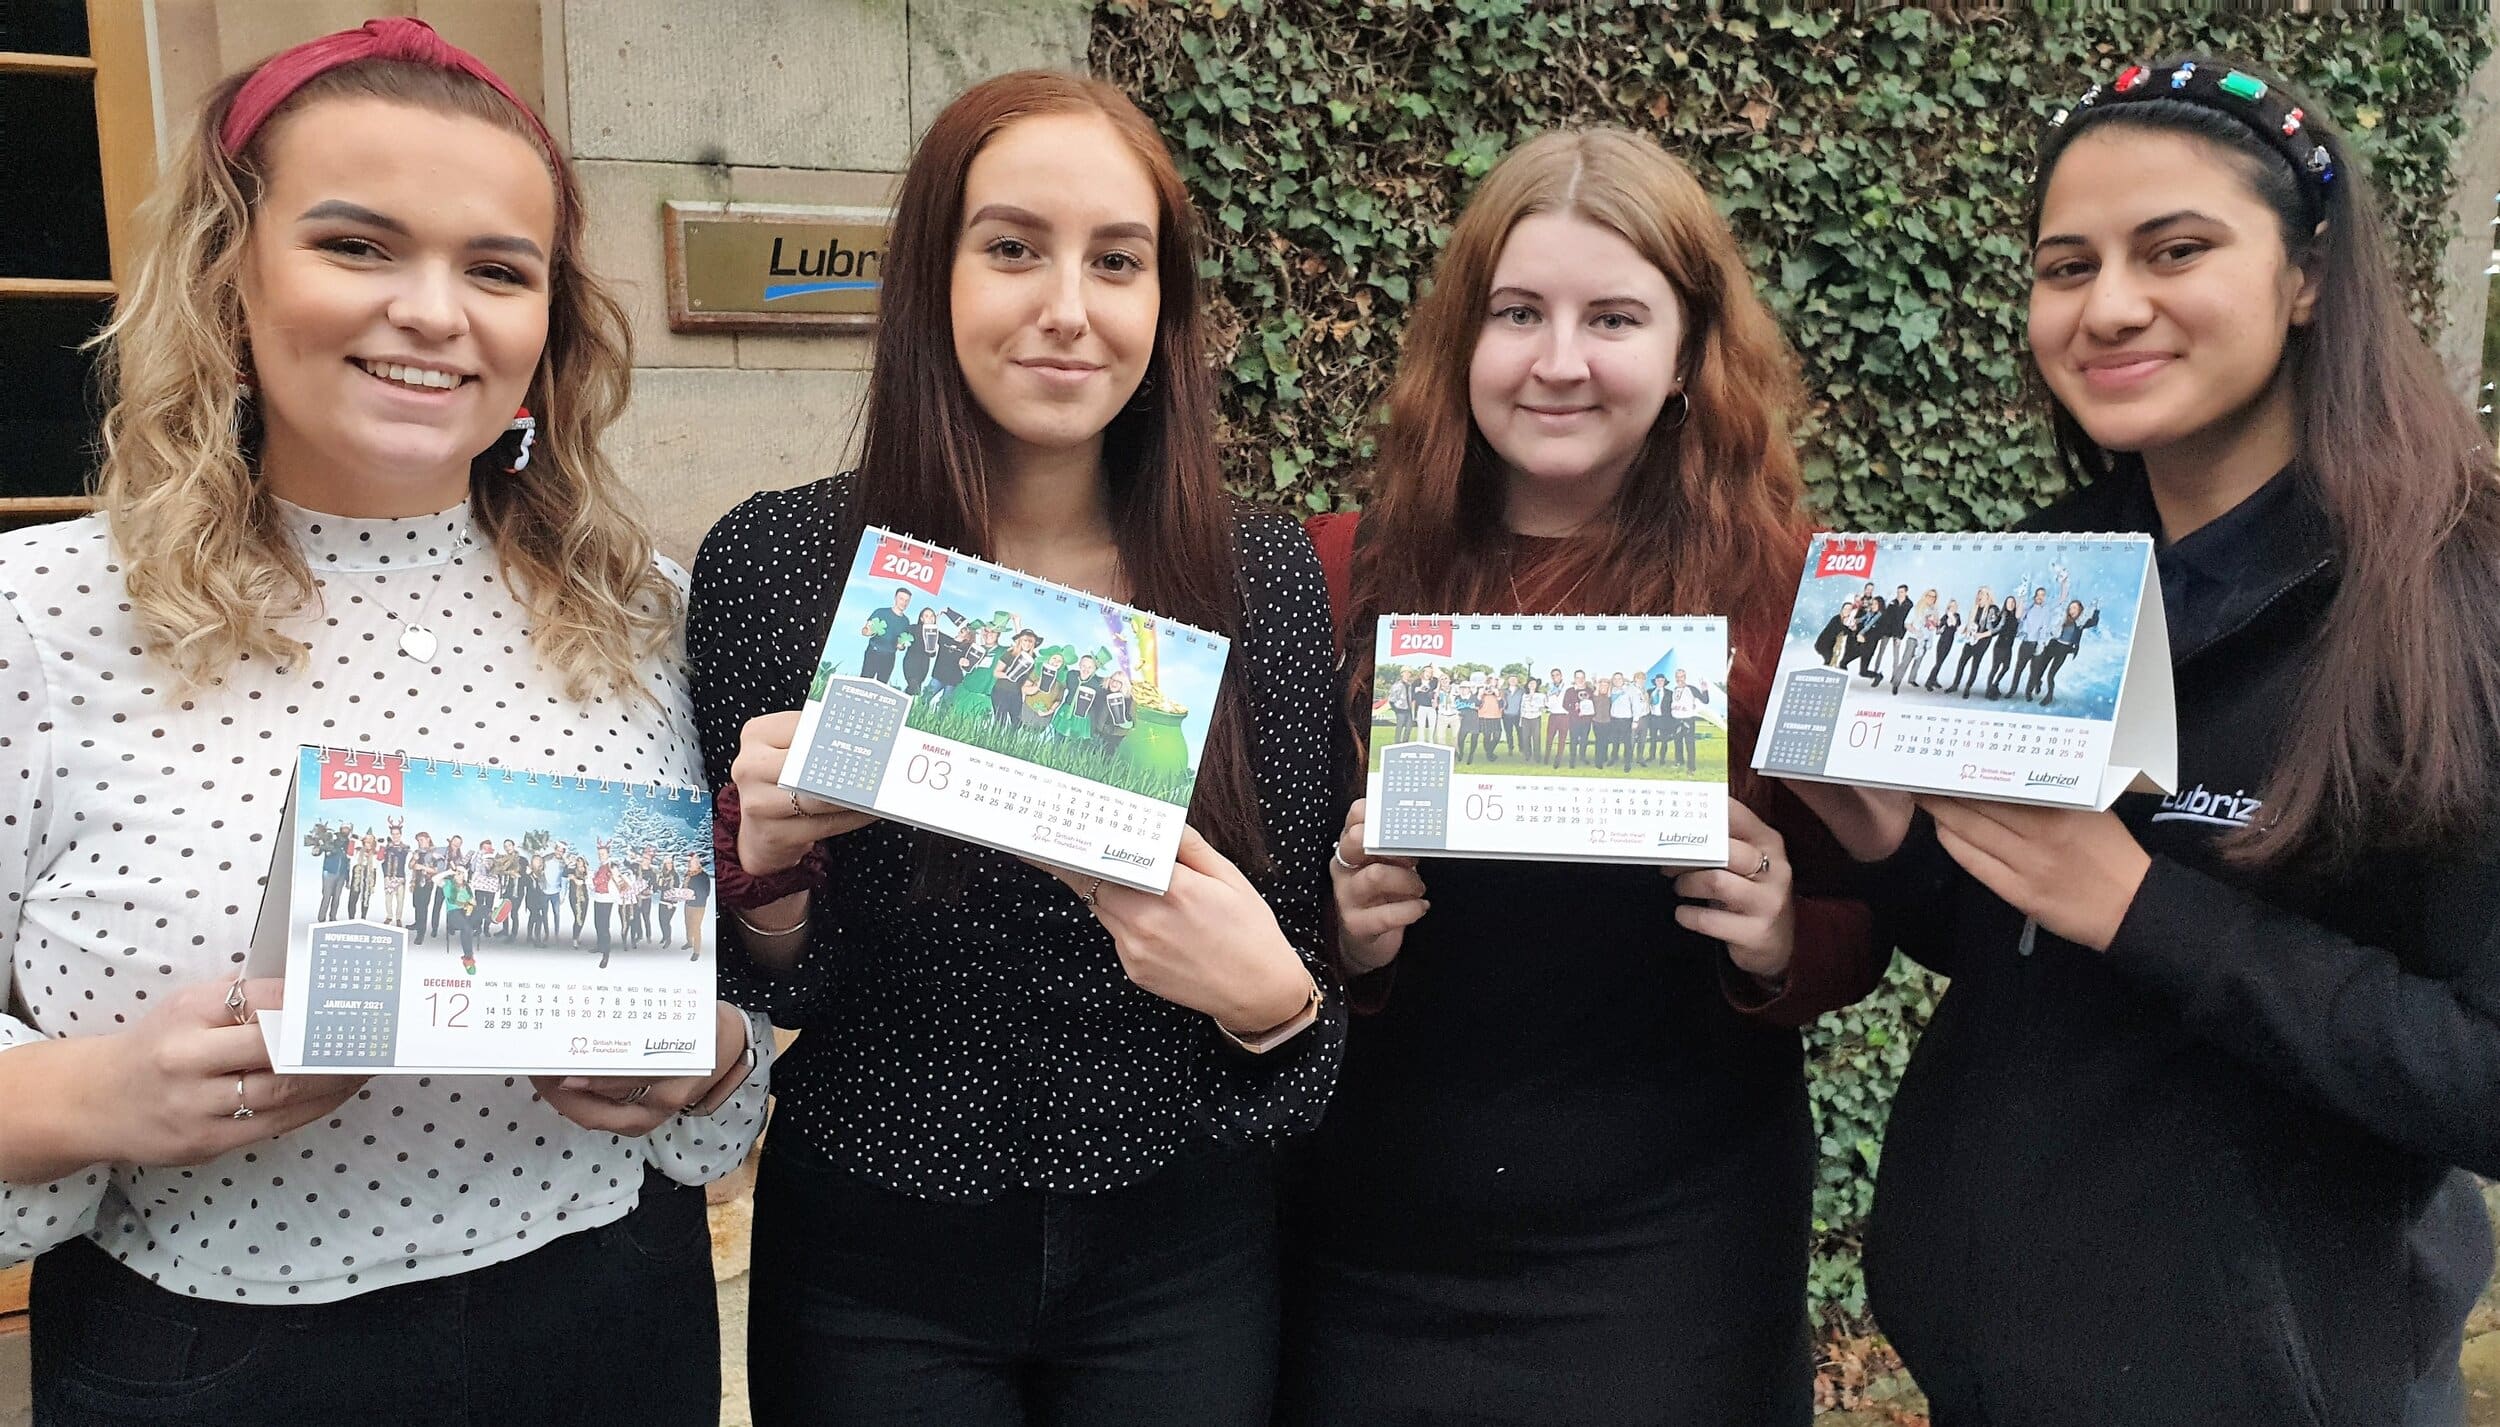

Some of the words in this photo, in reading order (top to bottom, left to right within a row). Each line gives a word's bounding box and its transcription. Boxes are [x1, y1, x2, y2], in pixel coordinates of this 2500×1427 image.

[883, 554, 934, 583] 2020
[1825, 555, 1867, 572] 2020
[1400, 634, 1444, 650] 2020
[1855, 710, 1885, 718] JANUARY
[1849, 721, 1882, 750] 01
[922, 744, 951, 757] MARCH
[907, 755, 951, 790] 03
[2028, 770, 2079, 786] Lubrizol
[333, 771, 391, 795] 2020
[959, 789, 970, 799] 23
[974, 794, 984, 802] 24
[989, 798, 999, 806] 25
[1004, 802, 1013, 811] 26
[1018, 806, 1029, 814] 27
[1062, 818, 1072, 827] 30
[1076, 822, 1086, 831] 31
[965, 779, 971, 787] 9
[979, 783, 988, 791] 10
[994, 787, 1002, 795] 11
[1008, 791, 1017, 800] 12
[1023, 795, 1032, 804] 13
[1066, 807, 1075, 816] 16
[1109, 820, 1118, 828] 19
[1084, 801, 1090, 809] 3
[1113, 809, 1118, 817] 5
[1127, 813, 1133, 821] 6
[1466, 794, 1503, 820] 05
[1659, 832, 1708, 844] Lubrizol
[1104, 844, 1155, 867] Lubrizol
[324, 933, 369, 943] NOVEMBER
[371, 936, 392, 944] 2020
[423, 979, 471, 988] DECEMBER
[323, 1000, 361, 1009] JANUARY
[363, 1001, 384, 1010] 2021
[506, 994, 509, 1002] 1
[521, 994, 527, 1003] 2
[537, 995, 543, 1003] 3
[553, 995, 558, 1003] 4
[600, 997, 605, 1005] 7
[615, 997, 620, 1006] 8
[630, 998, 636, 1006] 9
[644, 999, 653, 1007] 10
[658, 999, 666, 1007] 11
[425, 993, 469, 1027] 12
[486, 1007, 495, 1015] 14
[503, 1007, 512, 1016] 15
[519, 1008, 528, 1016] 16
[535, 1008, 544, 1016] 17
[551, 1009, 560, 1017] 18
[597, 1010, 606, 1018] 21
[612, 1010, 622, 1019] 22
[627, 1010, 637, 1019] 23
[643, 1011, 652, 1020] 24
[658, 1011, 667, 1020] 25
[484, 1020, 495, 1029] 28
[501, 1020, 511, 1029] 29
[517, 1021, 528, 1030] 30
[533, 1021, 543, 1030] 31
[645, 1038, 696, 1051] Lubrizol
